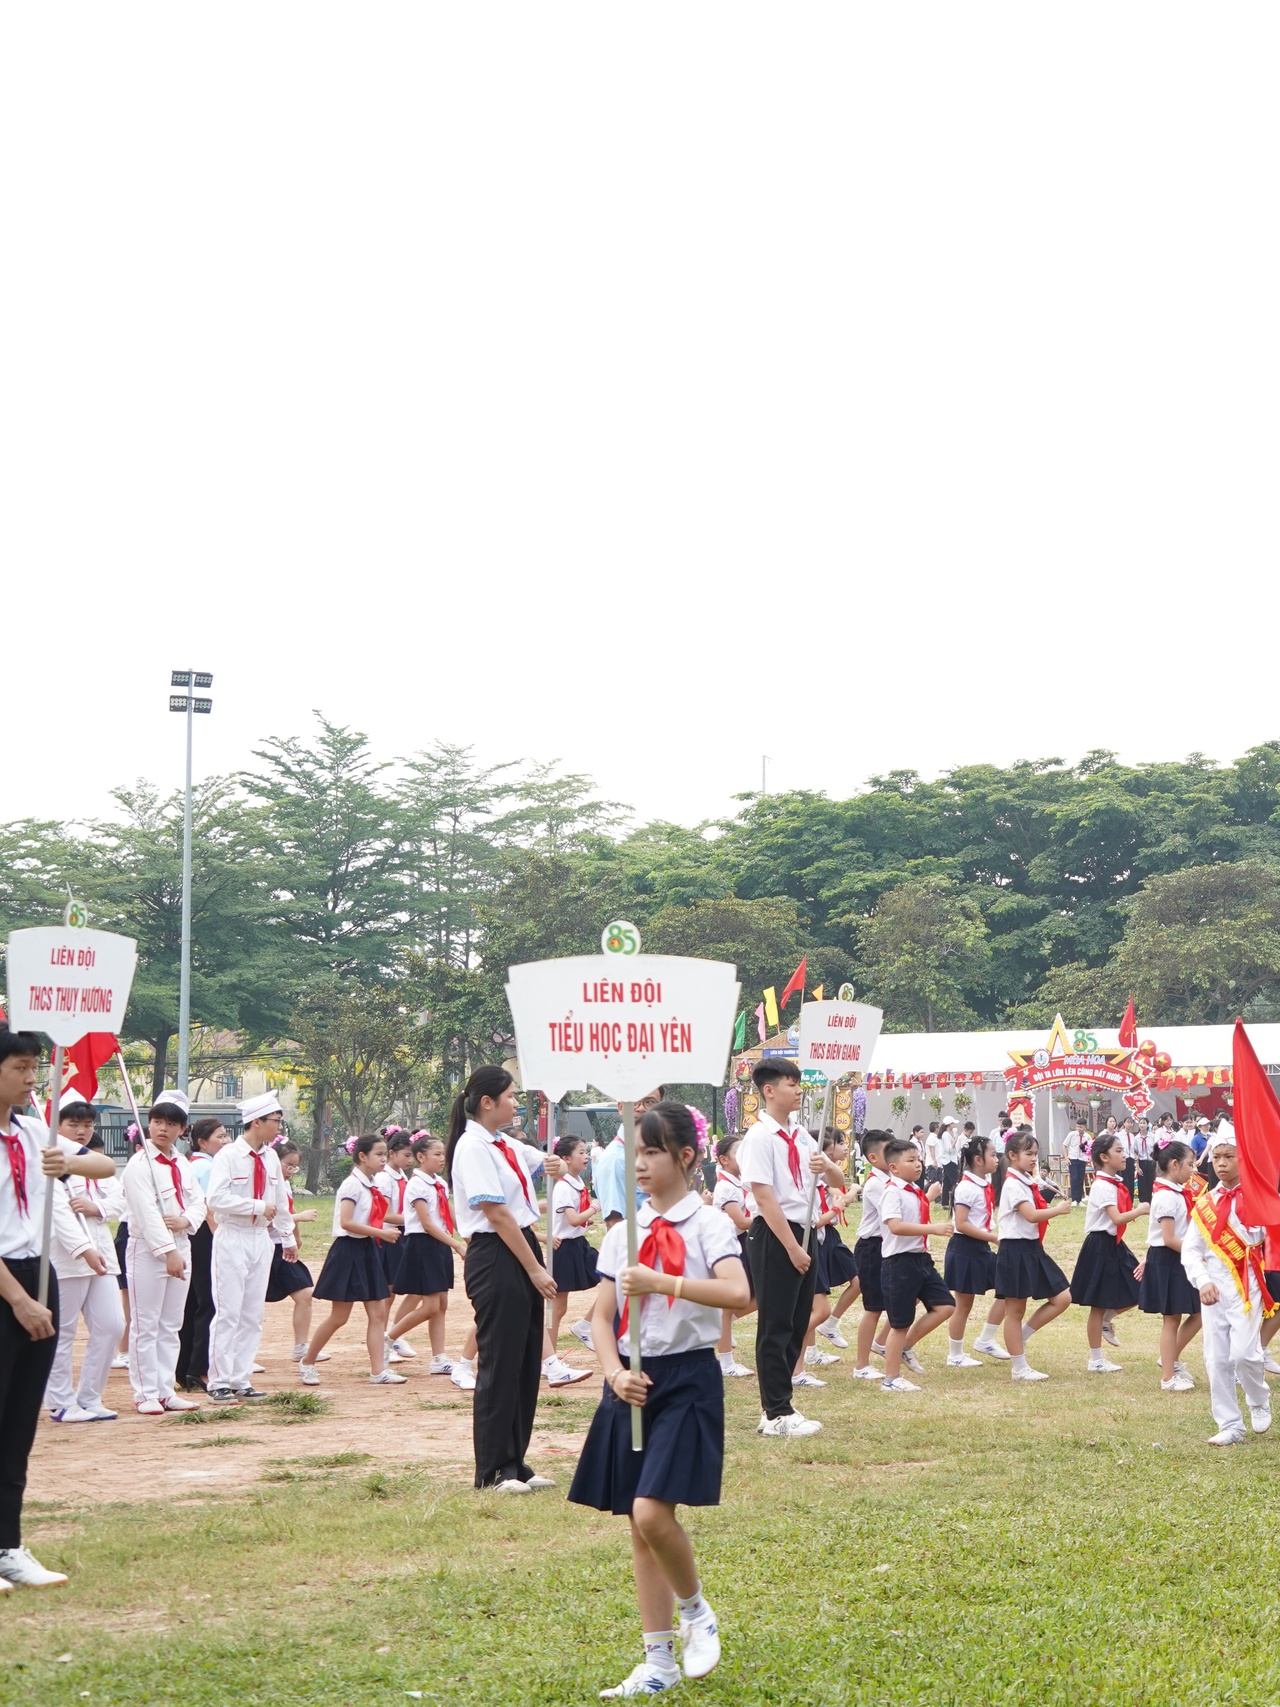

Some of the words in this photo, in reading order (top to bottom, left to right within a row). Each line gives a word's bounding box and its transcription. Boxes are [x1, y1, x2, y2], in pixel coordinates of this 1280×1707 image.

[69, 904, 86, 928] 85
[606, 924, 637, 955] 85
[51, 945, 75, 966] LIÊN
[77, 947, 96, 971] ĐỘI
[29, 986, 53, 1011] THCS
[80, 986, 112, 1013] HƯƠNG
[583, 978, 624, 1003] LIÊN
[631, 978, 662, 1007] ĐỘI
[842, 985, 853, 1001] 85
[827, 1013, 843, 1028] LIÊN
[844, 1015, 857, 1031] ĐỘI
[548, 1010, 584, 1052] TIỂU
[589, 1023, 621, 1059] HỌC
[627, 1023, 654, 1059] ĐẠI
[660, 1016, 692, 1052] YÊN
[1072, 1029, 1098, 1053] 85
[809, 1042, 826, 1060] THCS
[826, 1040, 841, 1060] BIÊN
[841, 1044, 861, 1061] GIANG
[1033, 1071, 1044, 1082] ĐỘI
[1044, 1070, 1052, 1078] TA
[1052, 1067, 1064, 1076] LỚN
[1065, 1066, 1077, 1076] LÊN
[1077, 1066, 1093, 1076] CÙNG
[1094, 1067, 1106, 1078] ĐẤT
[1106, 1071, 1123, 1083] NƯỚC
[1226, 1239, 1246, 1261] MINH
